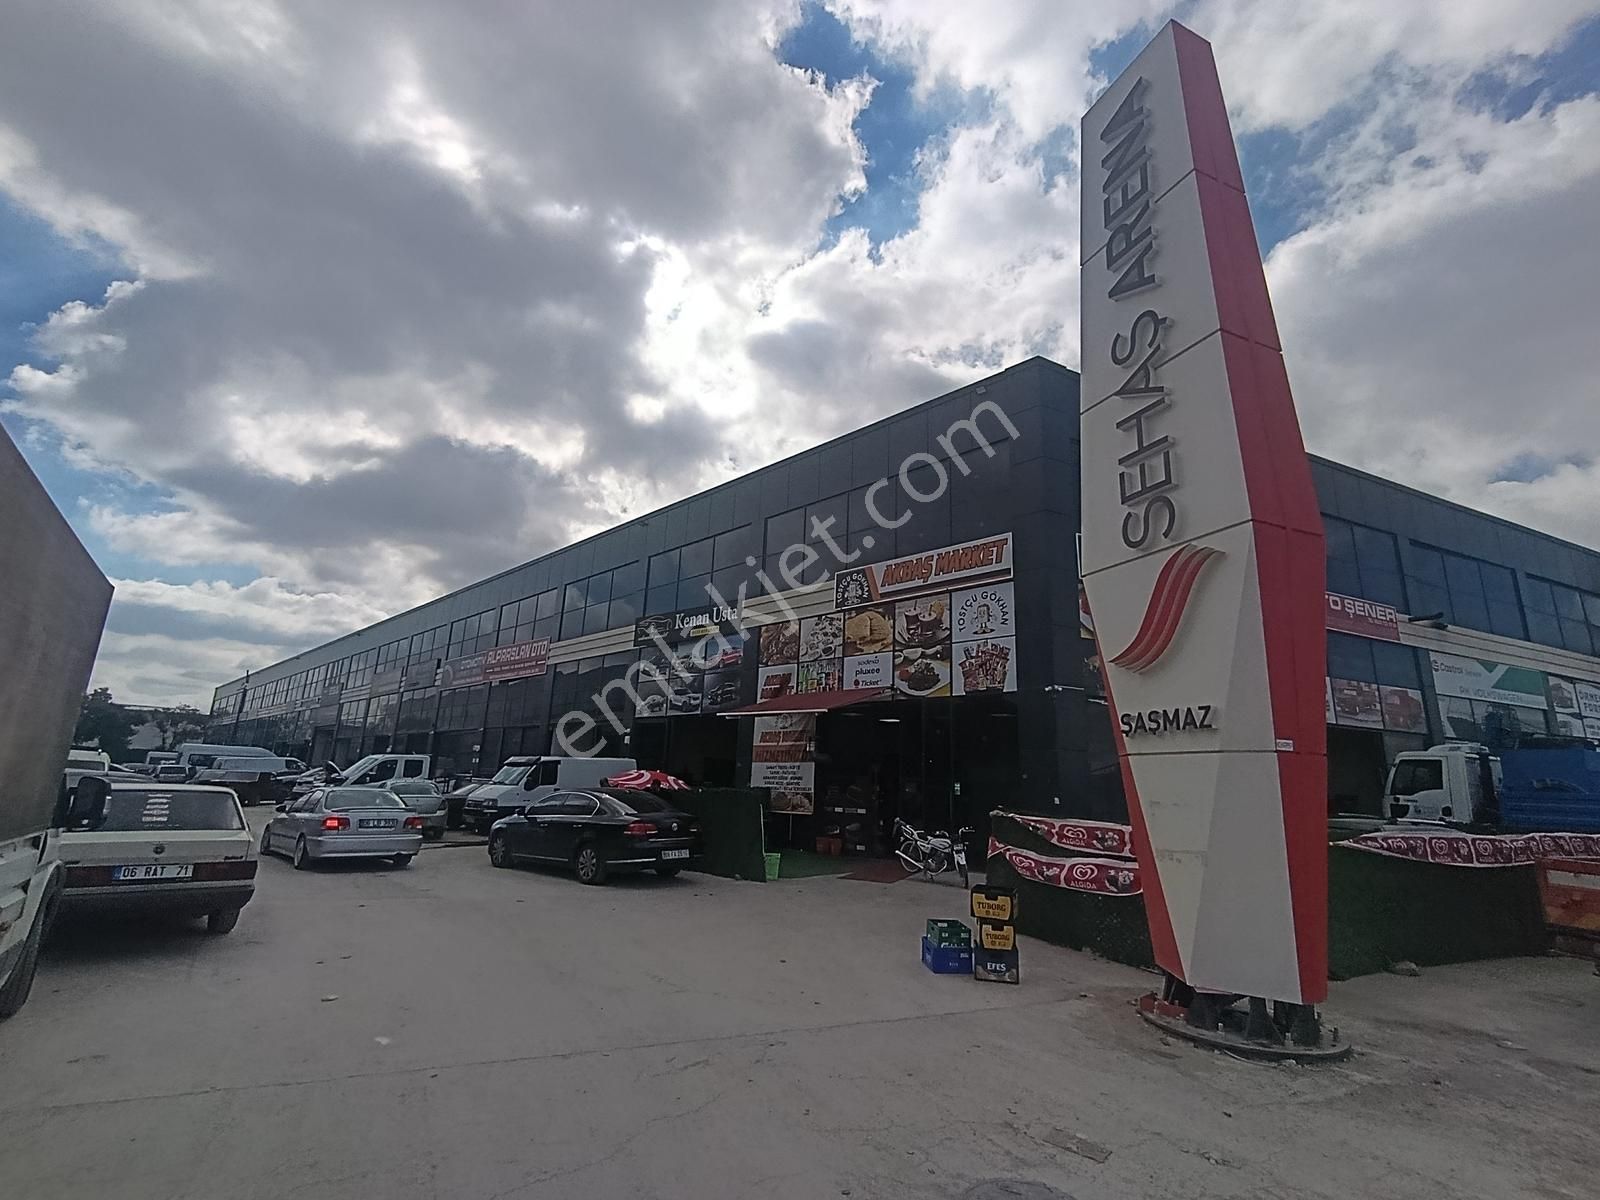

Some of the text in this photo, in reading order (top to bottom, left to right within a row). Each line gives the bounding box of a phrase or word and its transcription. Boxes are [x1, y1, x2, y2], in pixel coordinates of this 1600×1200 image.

[1100, 76, 1176, 548] SEHAŞ ARENA
[881, 538, 1007, 587] AKBAŞ MARKET
[674, 606, 738, 629] Kenan Usta
[957, 591, 1009, 632] TOSTÇU GÖKHAN
[1344, 599, 1396, 622] ŞENER
[486, 644, 532, 665] ALPARSLAN
[855, 667, 881, 678] pluxee
[861, 679, 880, 688] Ticket
[1120, 705, 1212, 737] ŞAŞMAZ
[122, 865, 188, 878] 06 RAT 71
[1070, 880, 1096, 889] ALGIDA
[976, 901, 1006, 912] TUBORG
[985, 932, 1010, 942] TUBORG
[987, 962, 1006, 972] EFES
